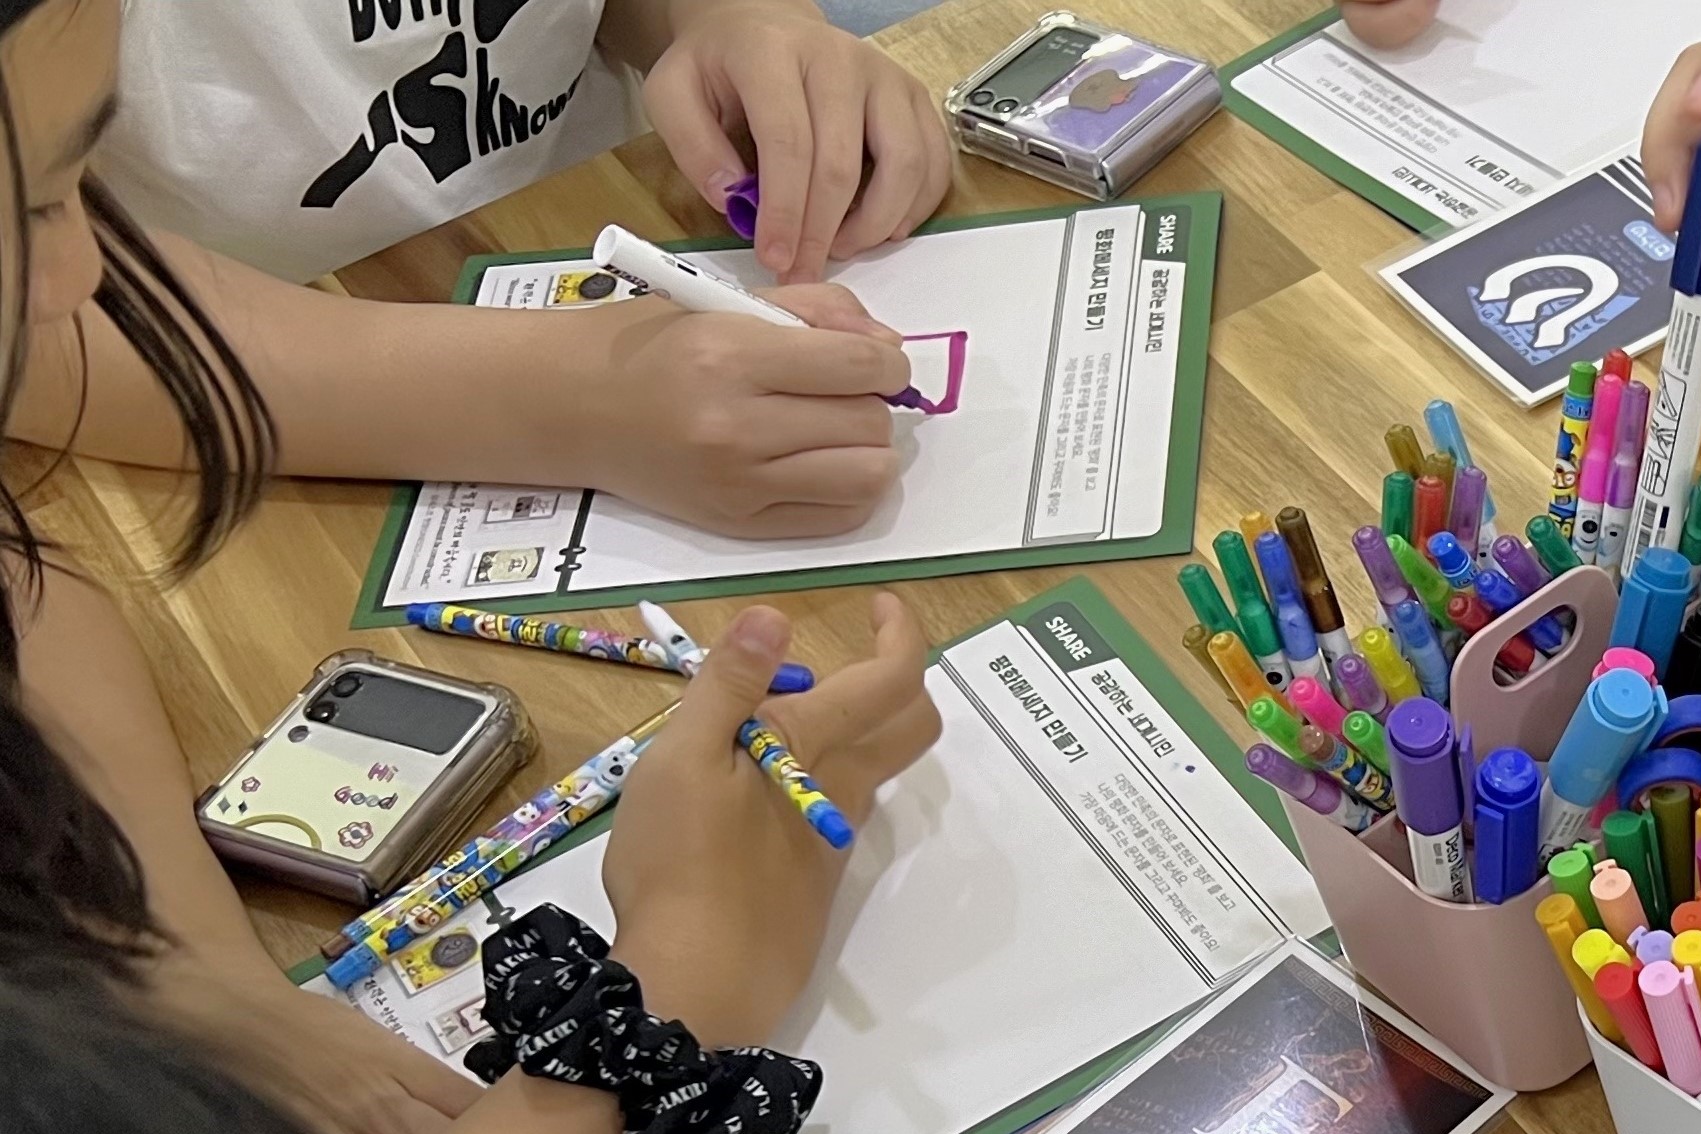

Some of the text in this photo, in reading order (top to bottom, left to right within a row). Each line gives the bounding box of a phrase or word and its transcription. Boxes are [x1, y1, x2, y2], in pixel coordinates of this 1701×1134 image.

[1157, 215, 1176, 254] SHARE
[1046, 617, 1092, 661] SHARE
[989, 655, 1088, 763] 평화메세지 만들기
[1091, 670, 1133, 715] 공감하는
